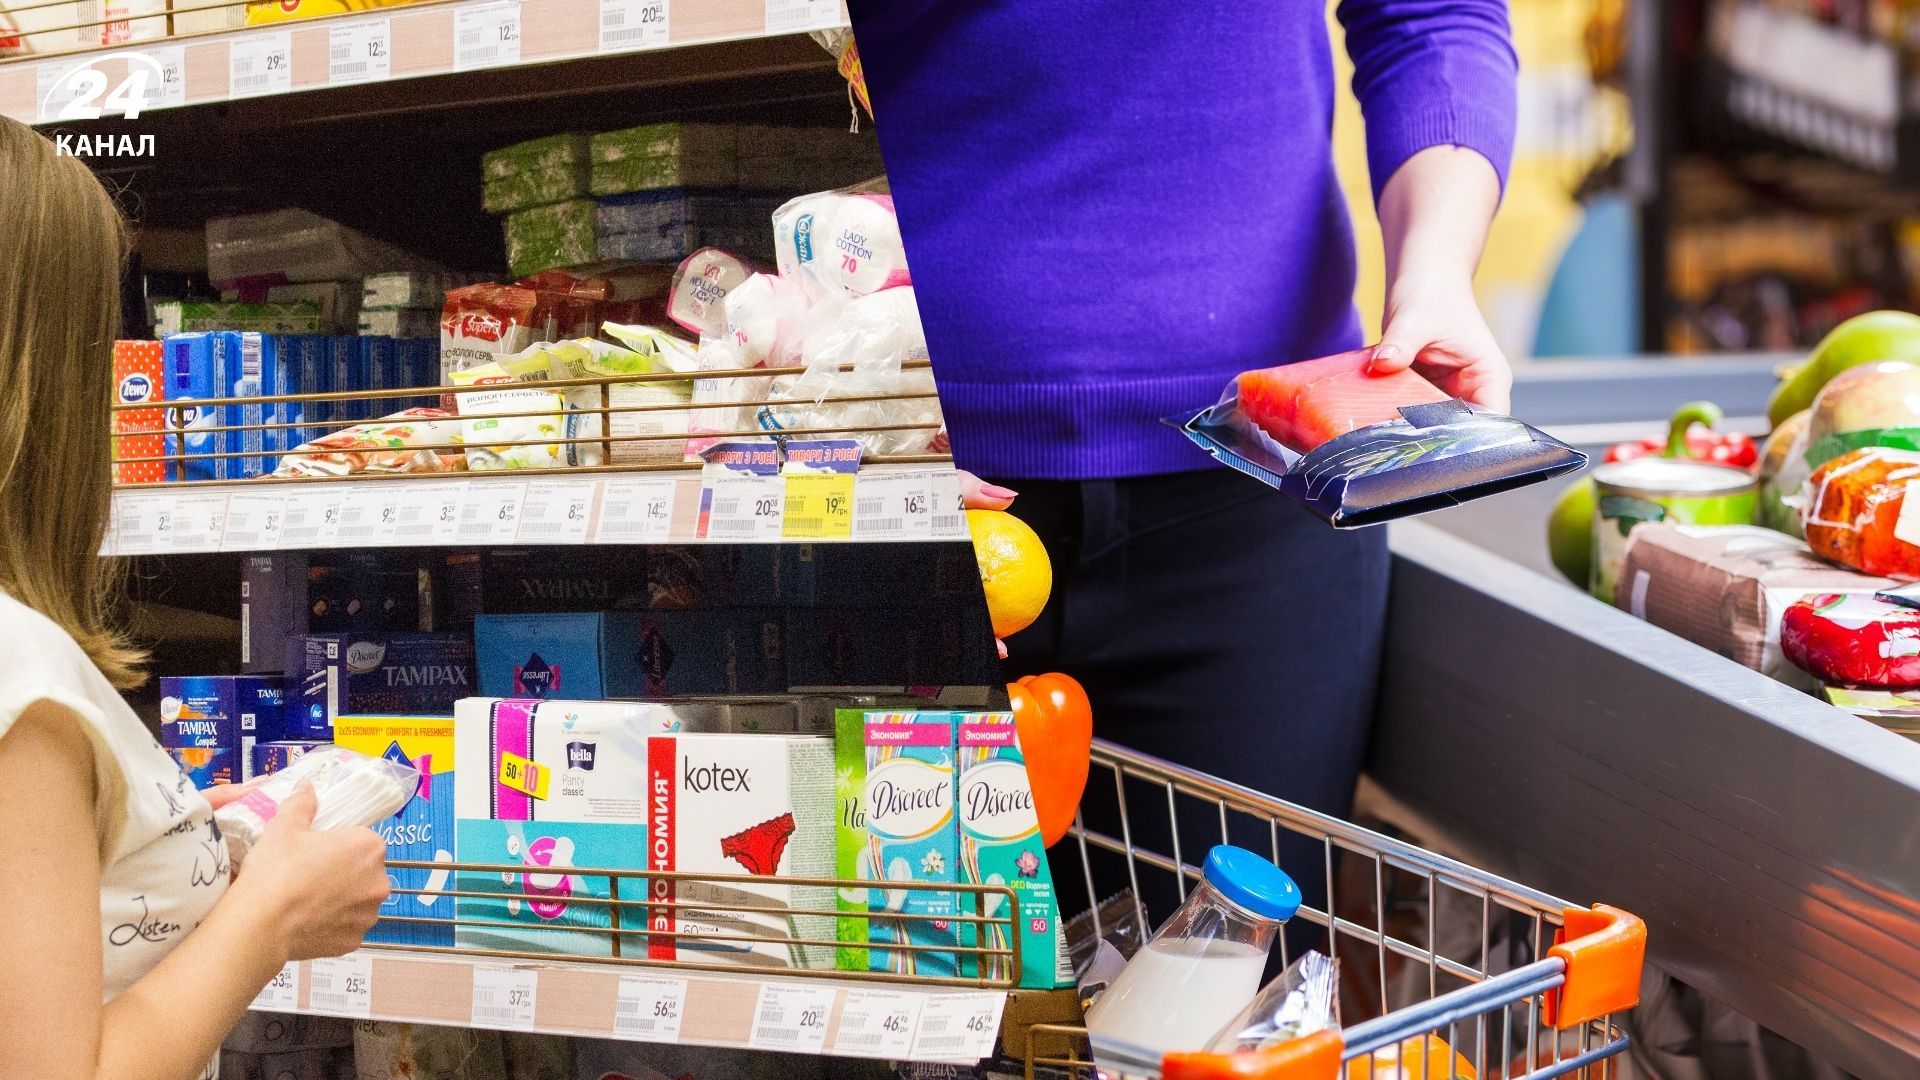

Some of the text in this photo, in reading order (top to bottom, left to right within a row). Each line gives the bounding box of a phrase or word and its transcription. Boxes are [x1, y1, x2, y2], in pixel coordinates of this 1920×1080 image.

[642, 7, 656, 23] 20
[499, 25, 510, 41] 12
[368, 41, 379, 57] 12
[267, 55, 279, 70] 29
[843, 228, 867, 247] LADY
[836, 237, 873, 260] COTTON
[841, 254, 857, 274] 70
[123, 381, 147, 397] Zewa
[788, 449, 823, 463] ТОВАРИ
[832, 447, 859, 462] РОСІЇ
[440, 506, 448, 521] 3
[499, 505, 506, 520] 6
[568, 504, 576, 520] 8
[647, 502, 659, 519] 14
[755, 499, 771, 516] 20
[825, 498, 838, 514] 19
[904, 497, 917, 514] 16
[158, 516, 165, 531] 2
[266, 516, 272, 530] 3
[325, 509, 333, 523] 9
[382, 508, 389, 523] 9
[383, 664, 468, 687] TAMPAX
[257, 689, 283, 699] TAMP
[177, 721, 218, 736] TAMPAX
[386, 727, 413, 737] COMFORT
[570, 748, 592, 762] bella
[562, 773, 585, 790] Panty
[684, 755, 751, 794] kotex
[562, 786, 585, 797] classic
[872, 779, 949, 820] Discreet
[967, 781, 1034, 822] Discree
[842, 796, 866, 830] Na
[372, 813, 432, 846] lassic
[109, 894, 181, 947] Listen
[1033, 921, 1046, 931] 60
[346, 977, 359, 993] 25
[509, 990, 523, 1006] 37
[653, 1000, 668, 1017] 56
[800, 1010, 817, 1027] 20
[883, 1015, 900, 1032] 46
[966, 1016, 983, 1032] 46
